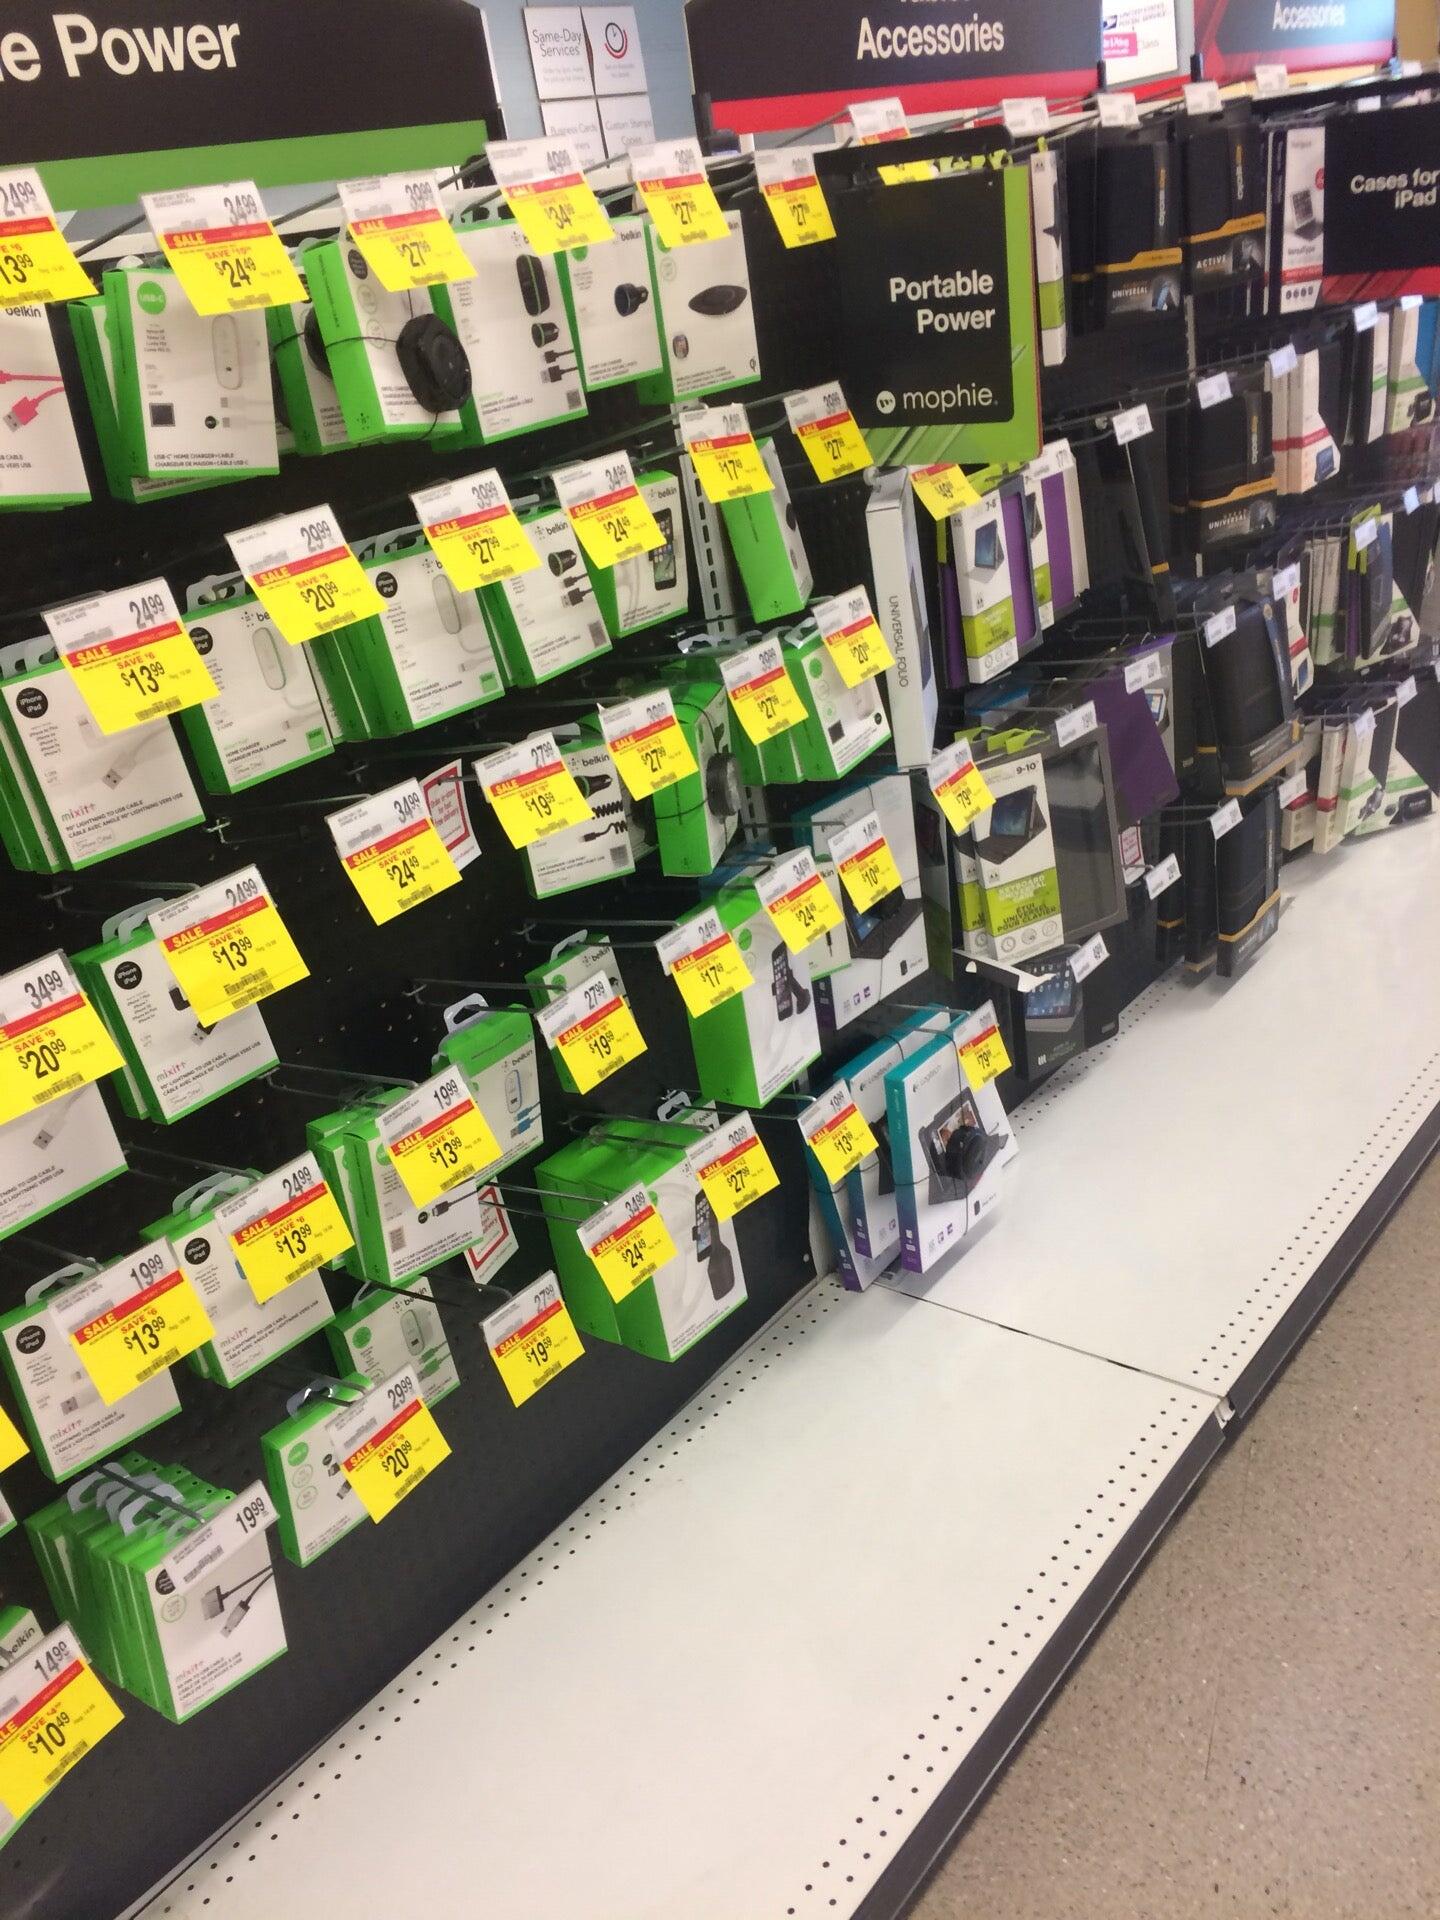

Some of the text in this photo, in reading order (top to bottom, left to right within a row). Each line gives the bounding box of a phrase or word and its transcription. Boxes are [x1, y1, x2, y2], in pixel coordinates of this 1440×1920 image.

[532, 28, 582, 46] Same-Day
[857, 13, 1005, 60] Accessories
[0, 13, 241, 81] e Power
[540, 43, 580, 57] Services
[1350, 167, 1440, 195] Cases for
[1394, 186, 1437, 210] iPad
[172, 231, 205, 248] SALE
[619, 229, 642, 241] belkin
[204, 248, 231, 260] SAVE
[890, 270, 994, 302] Portable
[917, 308, 996, 333] Power
[657, 486, 678, 499] belkin
[433, 519, 459, 536] SALE
[545, 521, 568, 536] belkin
[259, 565, 291, 584] SALE
[296, 575, 319, 588] SAVE
[888, 595, 909, 688] UNIVERSAL FOLIO
[76, 645, 113, 664] SALE
[115, 656, 144, 669] SAVE
[20, 694, 43, 706] iPhone
[26, 702, 43, 713] iPad
[614, 735, 636, 751] SALE
[582, 754, 610, 768] belkin
[1016, 762, 1037, 774] 9-10
[495, 776, 519, 793] SALE
[76, 813, 107, 828] LIGHTNING
[114, 806, 126, 815] USB
[126, 799, 144, 810] CABLE
[87, 791, 184, 832] AVEC ANGLE LIGHTNING VERS USB
[352, 846, 378, 866] SALE
[377, 857, 399, 869] SAVE
[996, 906, 1057, 933] POUR CLAVIER
[172, 926, 206, 948] SALE
[208, 933, 234, 949] SAVE
[591, 946, 611, 962] belkin
[117, 967, 137, 979] iPhone
[563, 1024, 583, 1043] SALE
[13, 1037, 44, 1054] SAVE
[211, 1052, 227, 1064] CABLE
[511, 1049, 533, 1066] belkin
[397, 1130, 424, 1153] SALE
[426, 1135, 446, 1149] SAVE
[241, 1218, 271, 1241] SALE
[273, 1222, 296, 1238] SAVE
[596, 1234, 615, 1253] SALE
[404, 1287, 427, 1306] bein
[83, 1313, 114, 1338] SALE
[120, 1316, 146, 1334] SAVE
[500, 1333, 521, 1354] SALE
[352, 1442, 374, 1470] SALE
[377, 1440, 397, 1459] SAVE
[19, 1717, 46, 1742] SAVE
